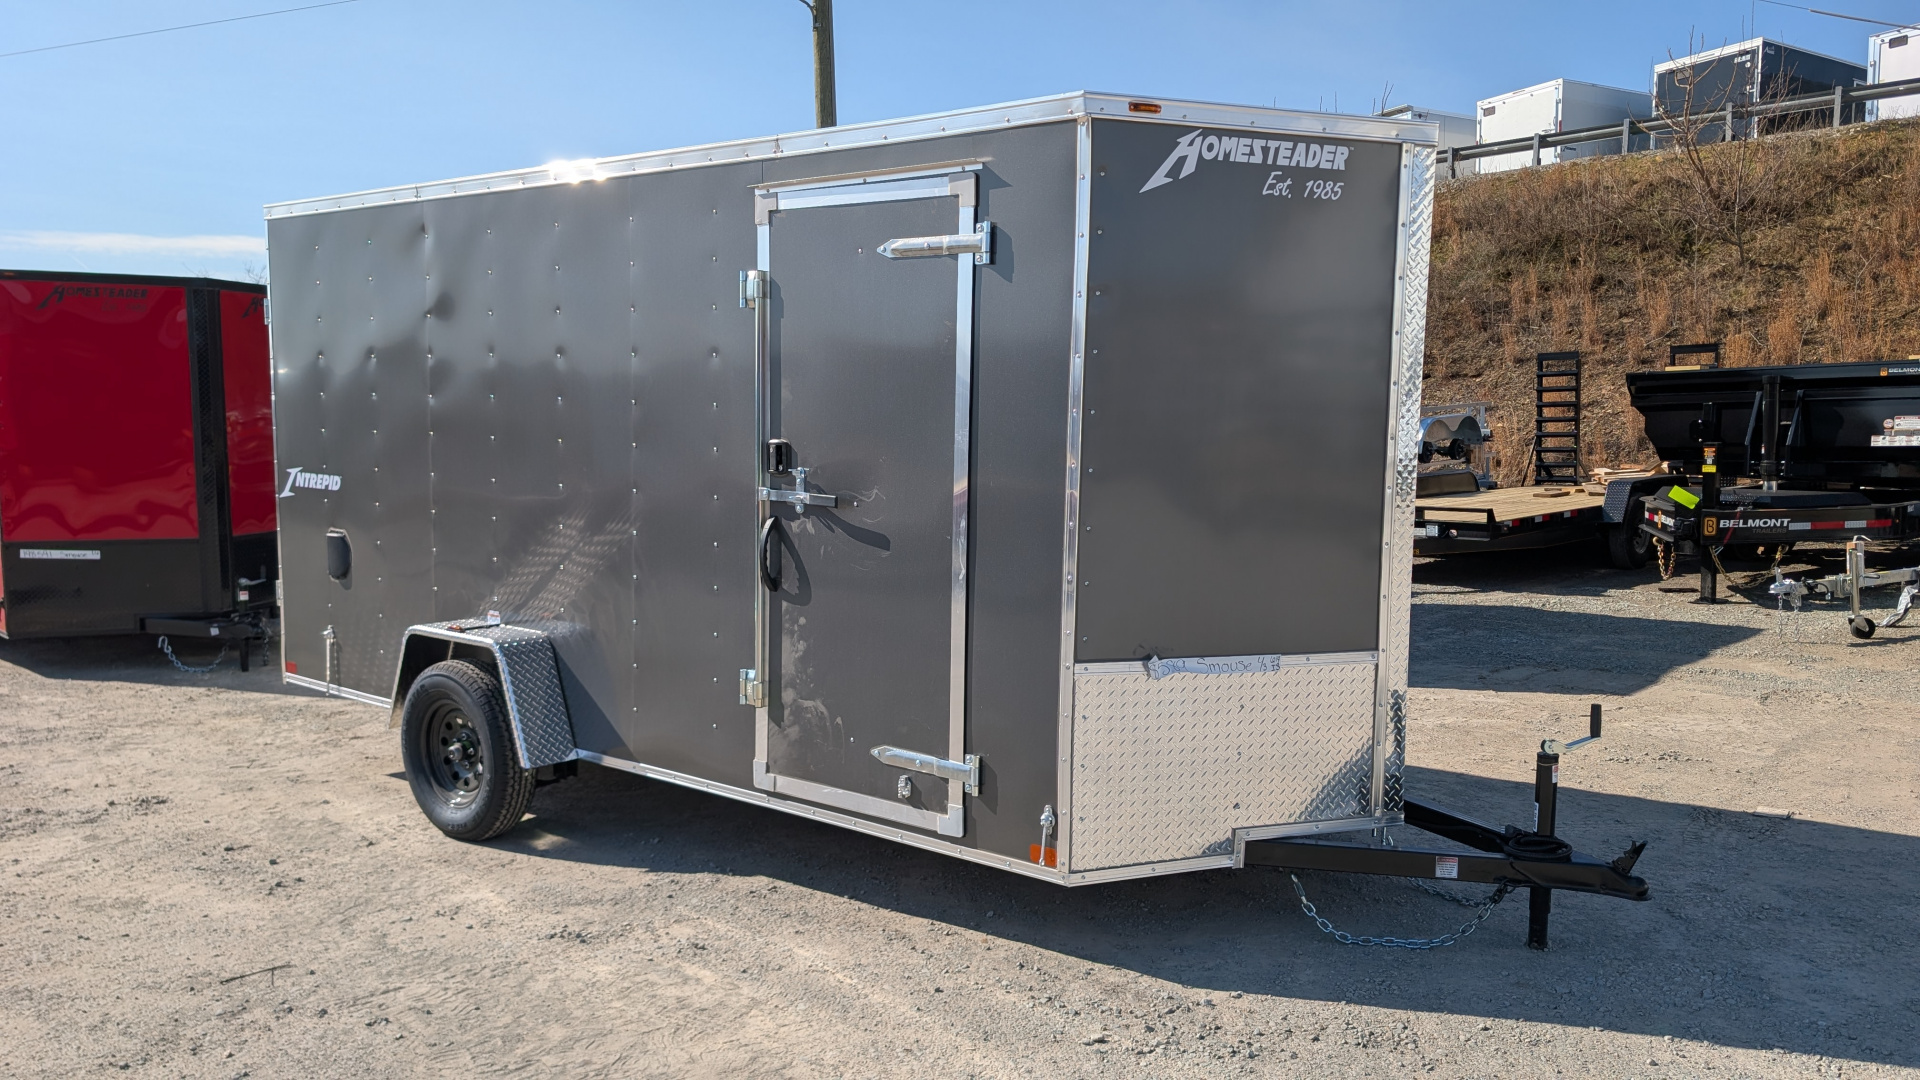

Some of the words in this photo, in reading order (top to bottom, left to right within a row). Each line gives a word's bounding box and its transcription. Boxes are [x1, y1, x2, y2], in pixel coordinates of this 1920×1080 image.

[1139, 129, 1349, 193] HOMESTEADER
[1262, 171, 1292, 198] Est.
[1304, 180, 1344, 200] 1985
[35, 284, 148, 310] HOMESTEADER
[279, 466, 342, 498] INTREPID
[1719, 518, 1791, 528] BELMONT
[1196, 657, 1252, 674] Smouse
